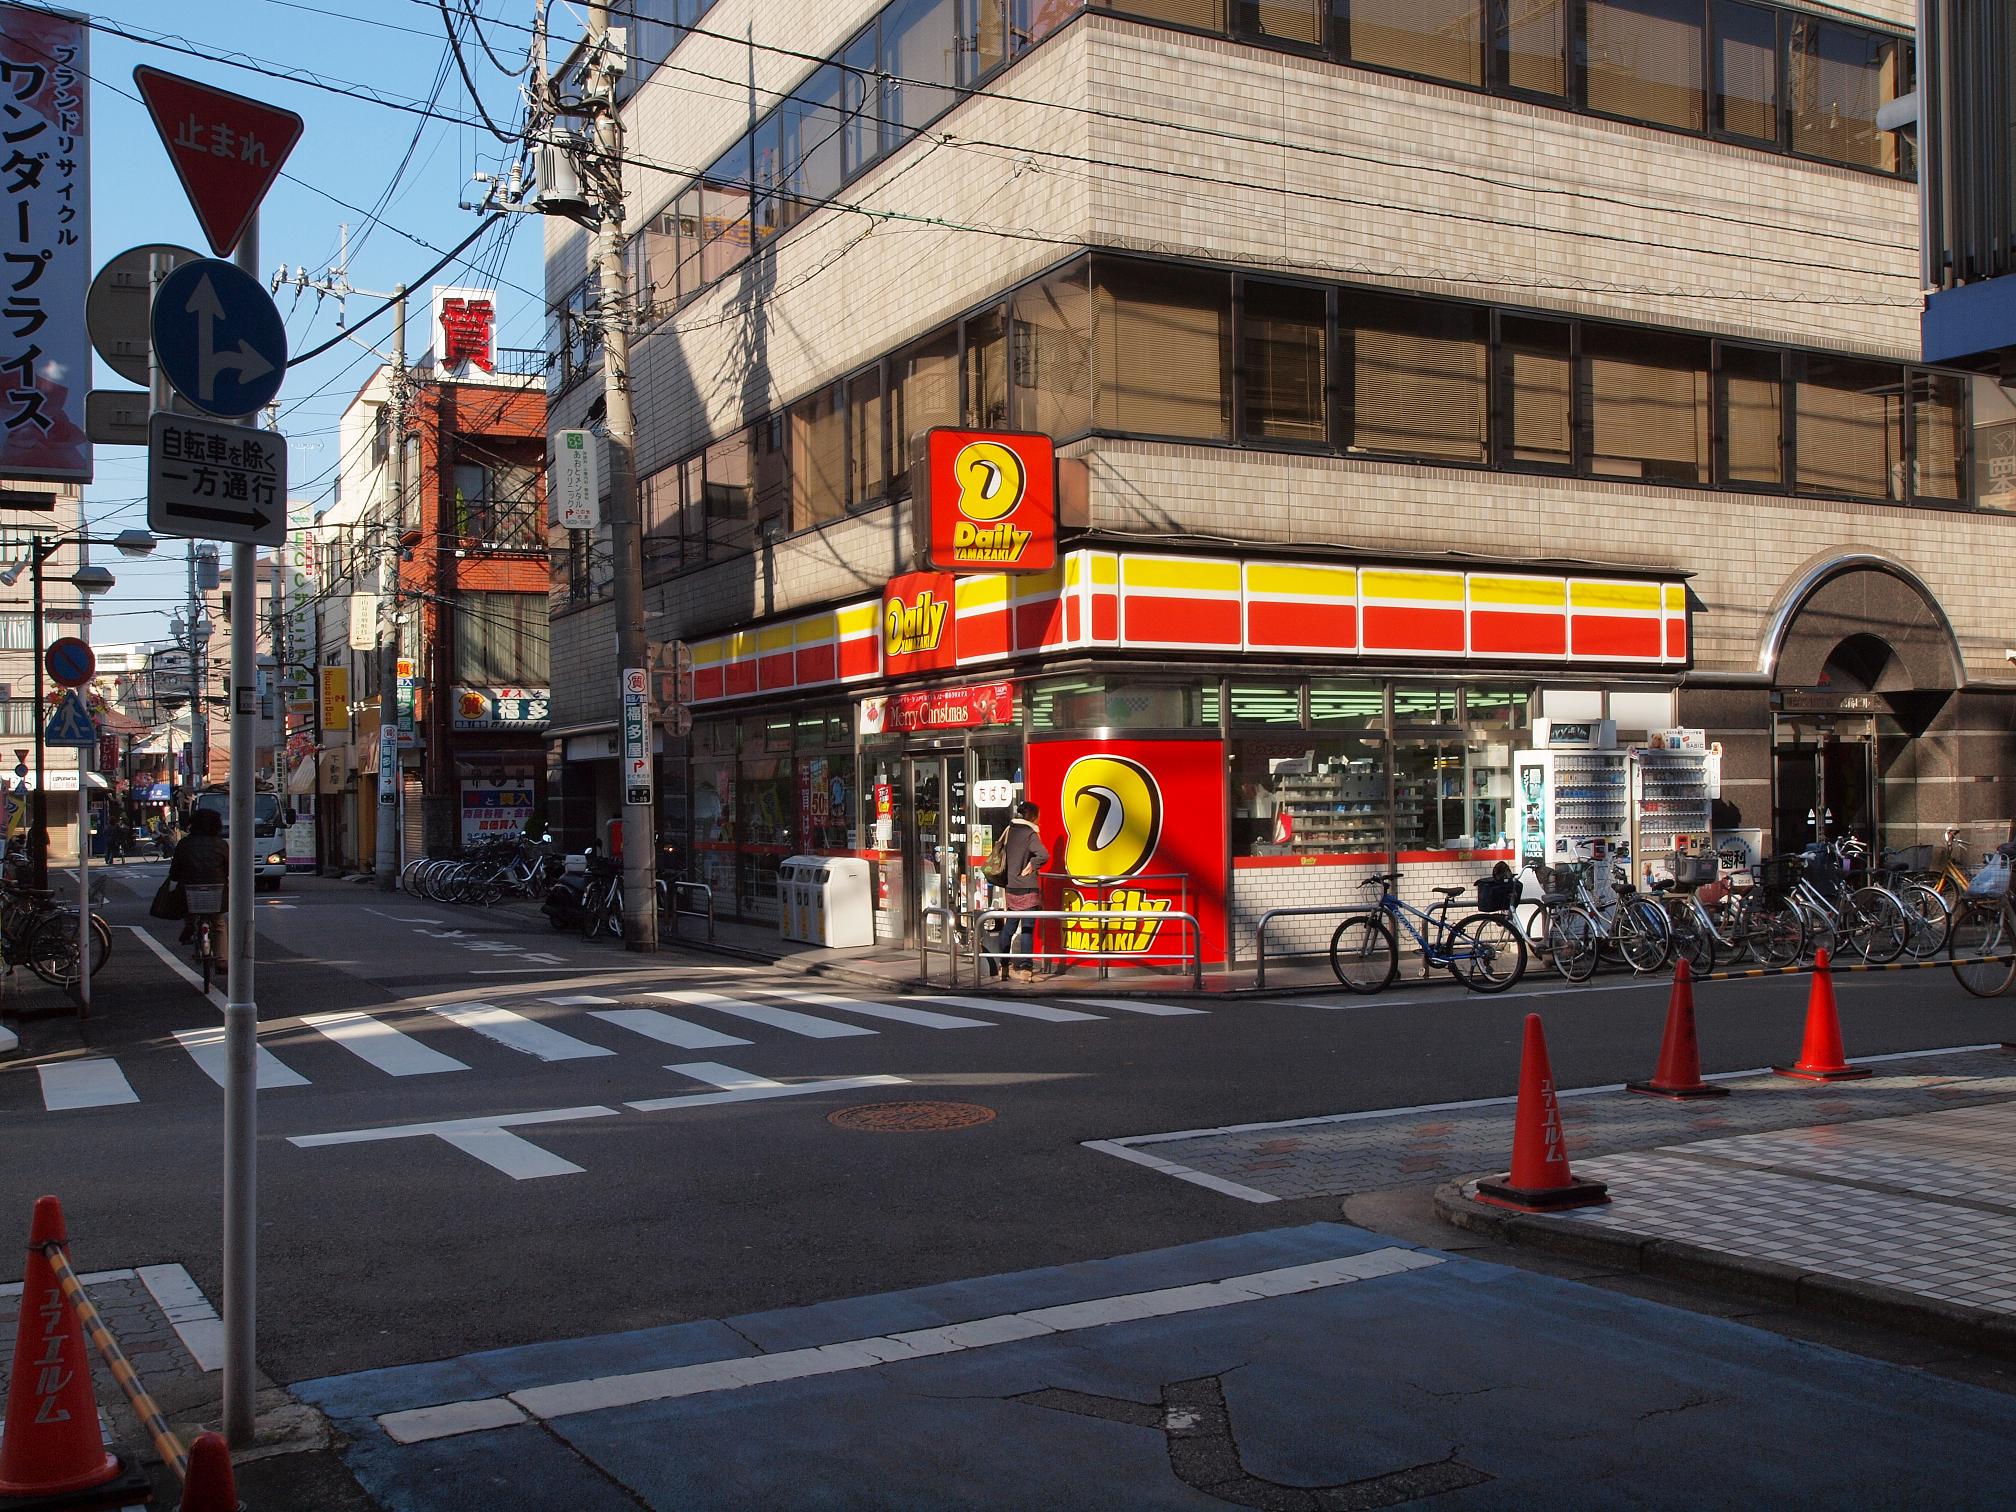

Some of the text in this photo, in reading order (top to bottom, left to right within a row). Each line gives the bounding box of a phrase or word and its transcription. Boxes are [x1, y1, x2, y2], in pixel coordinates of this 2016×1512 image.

[55, 46, 80, 246] ブランドリサイクル
[175, 113, 270, 168] 止まれ
[0, 62, 53, 436] ワンダープライス
[440, 297, 496, 373] 質
[162, 427, 276, 471] 自転車を除く
[162, 468, 276, 506] 一方通行
[955, 521, 1032, 562] Daily
[955, 548, 1010, 561] YAMAZAKI
[885, 590, 949, 657] Daily
[901, 635, 931, 654] YAMAZAKI
[631, 676, 643, 690] 質
[463, 696, 480, 714] 質
[890, 701, 969, 731] Merry Christmas
[627, 705, 642, 758] 福多屋
[979, 785, 1008, 802] たばこ
[1719, 849, 1746, 869] 歯科
[1061, 930, 1134, 952] YAMAZAKI
[1062, 888, 1172, 953] Daily
[1541, 1079, 1564, 1163] ユアエルム
[33, 1287, 74, 1424] ユアエルム
